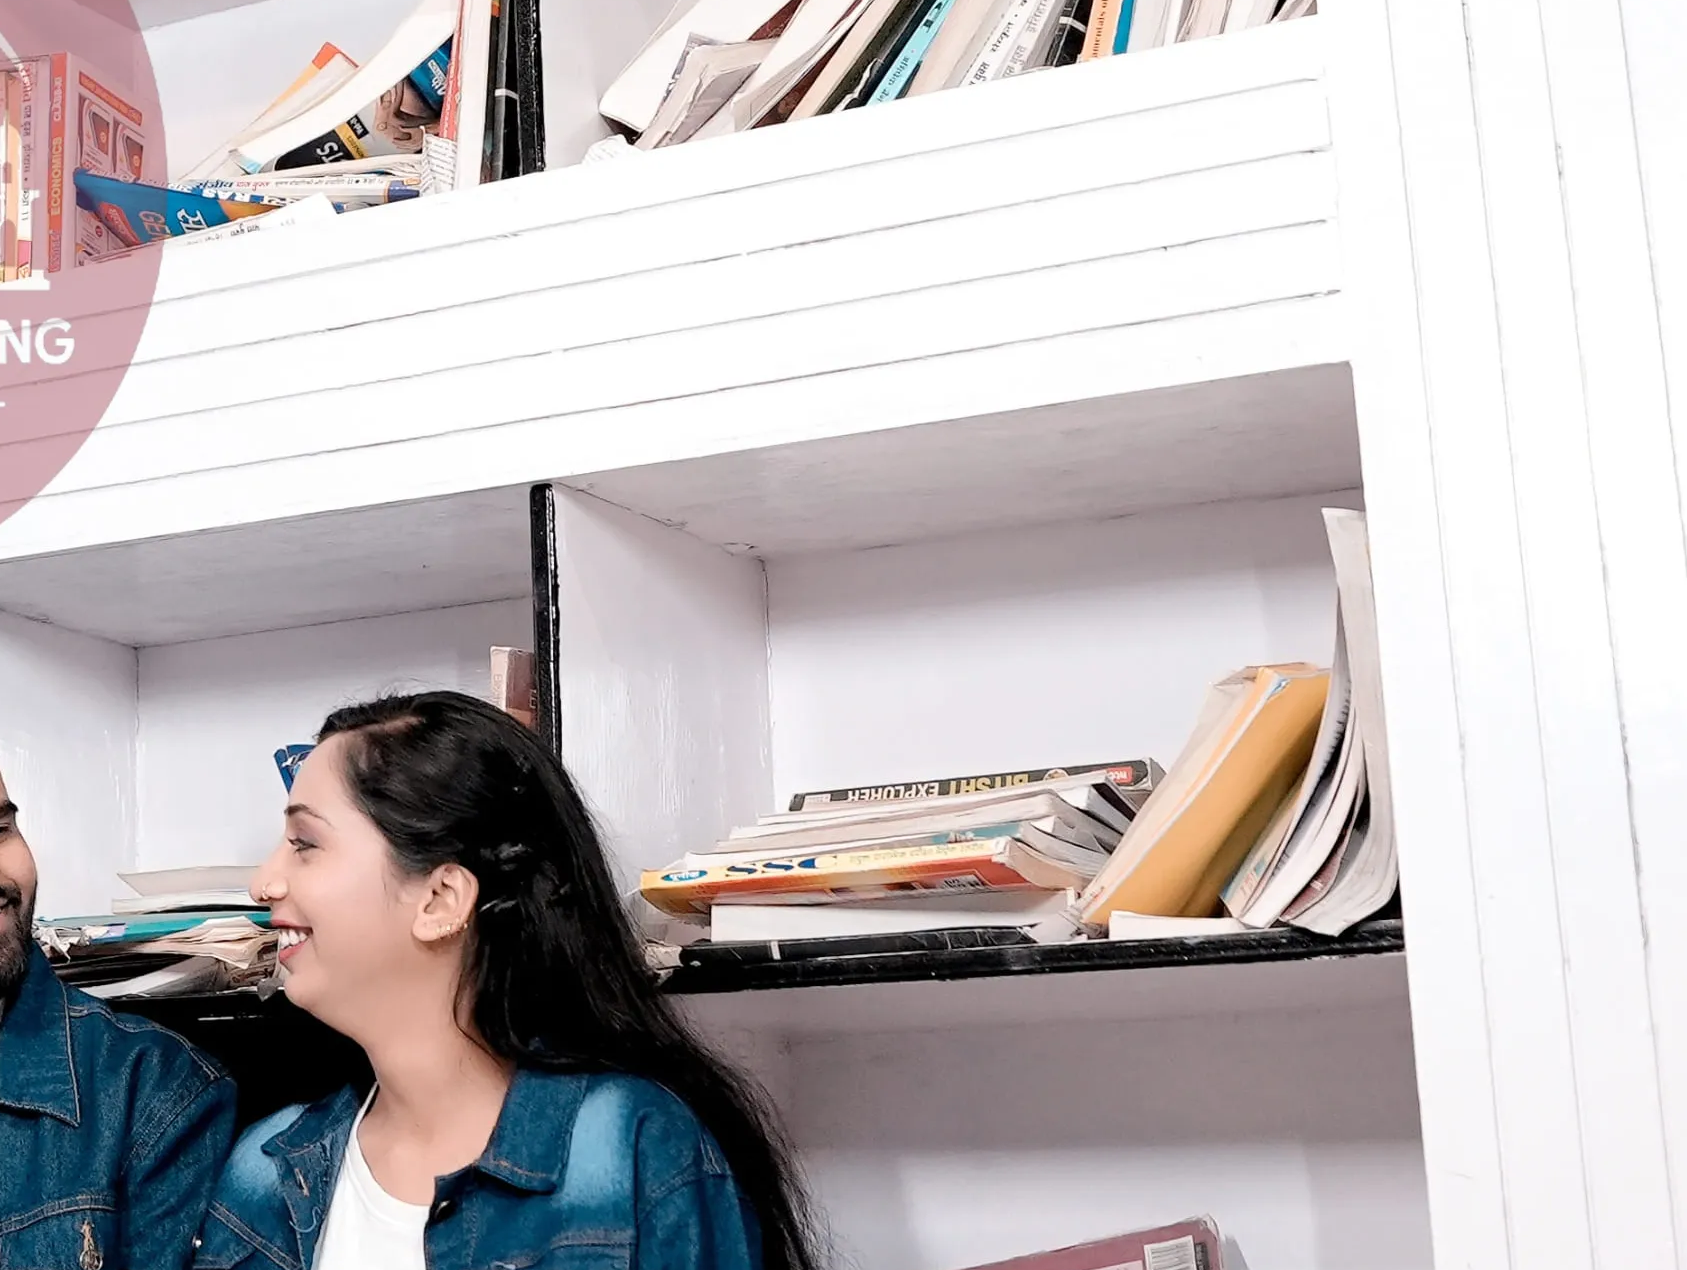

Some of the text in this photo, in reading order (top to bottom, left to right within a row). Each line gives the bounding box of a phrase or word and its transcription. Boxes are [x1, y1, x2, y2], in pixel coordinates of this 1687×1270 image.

[51, 137, 62, 214] ECONOMICS
[202, 188, 248, 201] RAS
[845, 771, 1030, 804] BITSAT EXPLORER
[726, 856, 838, 878] SSC
